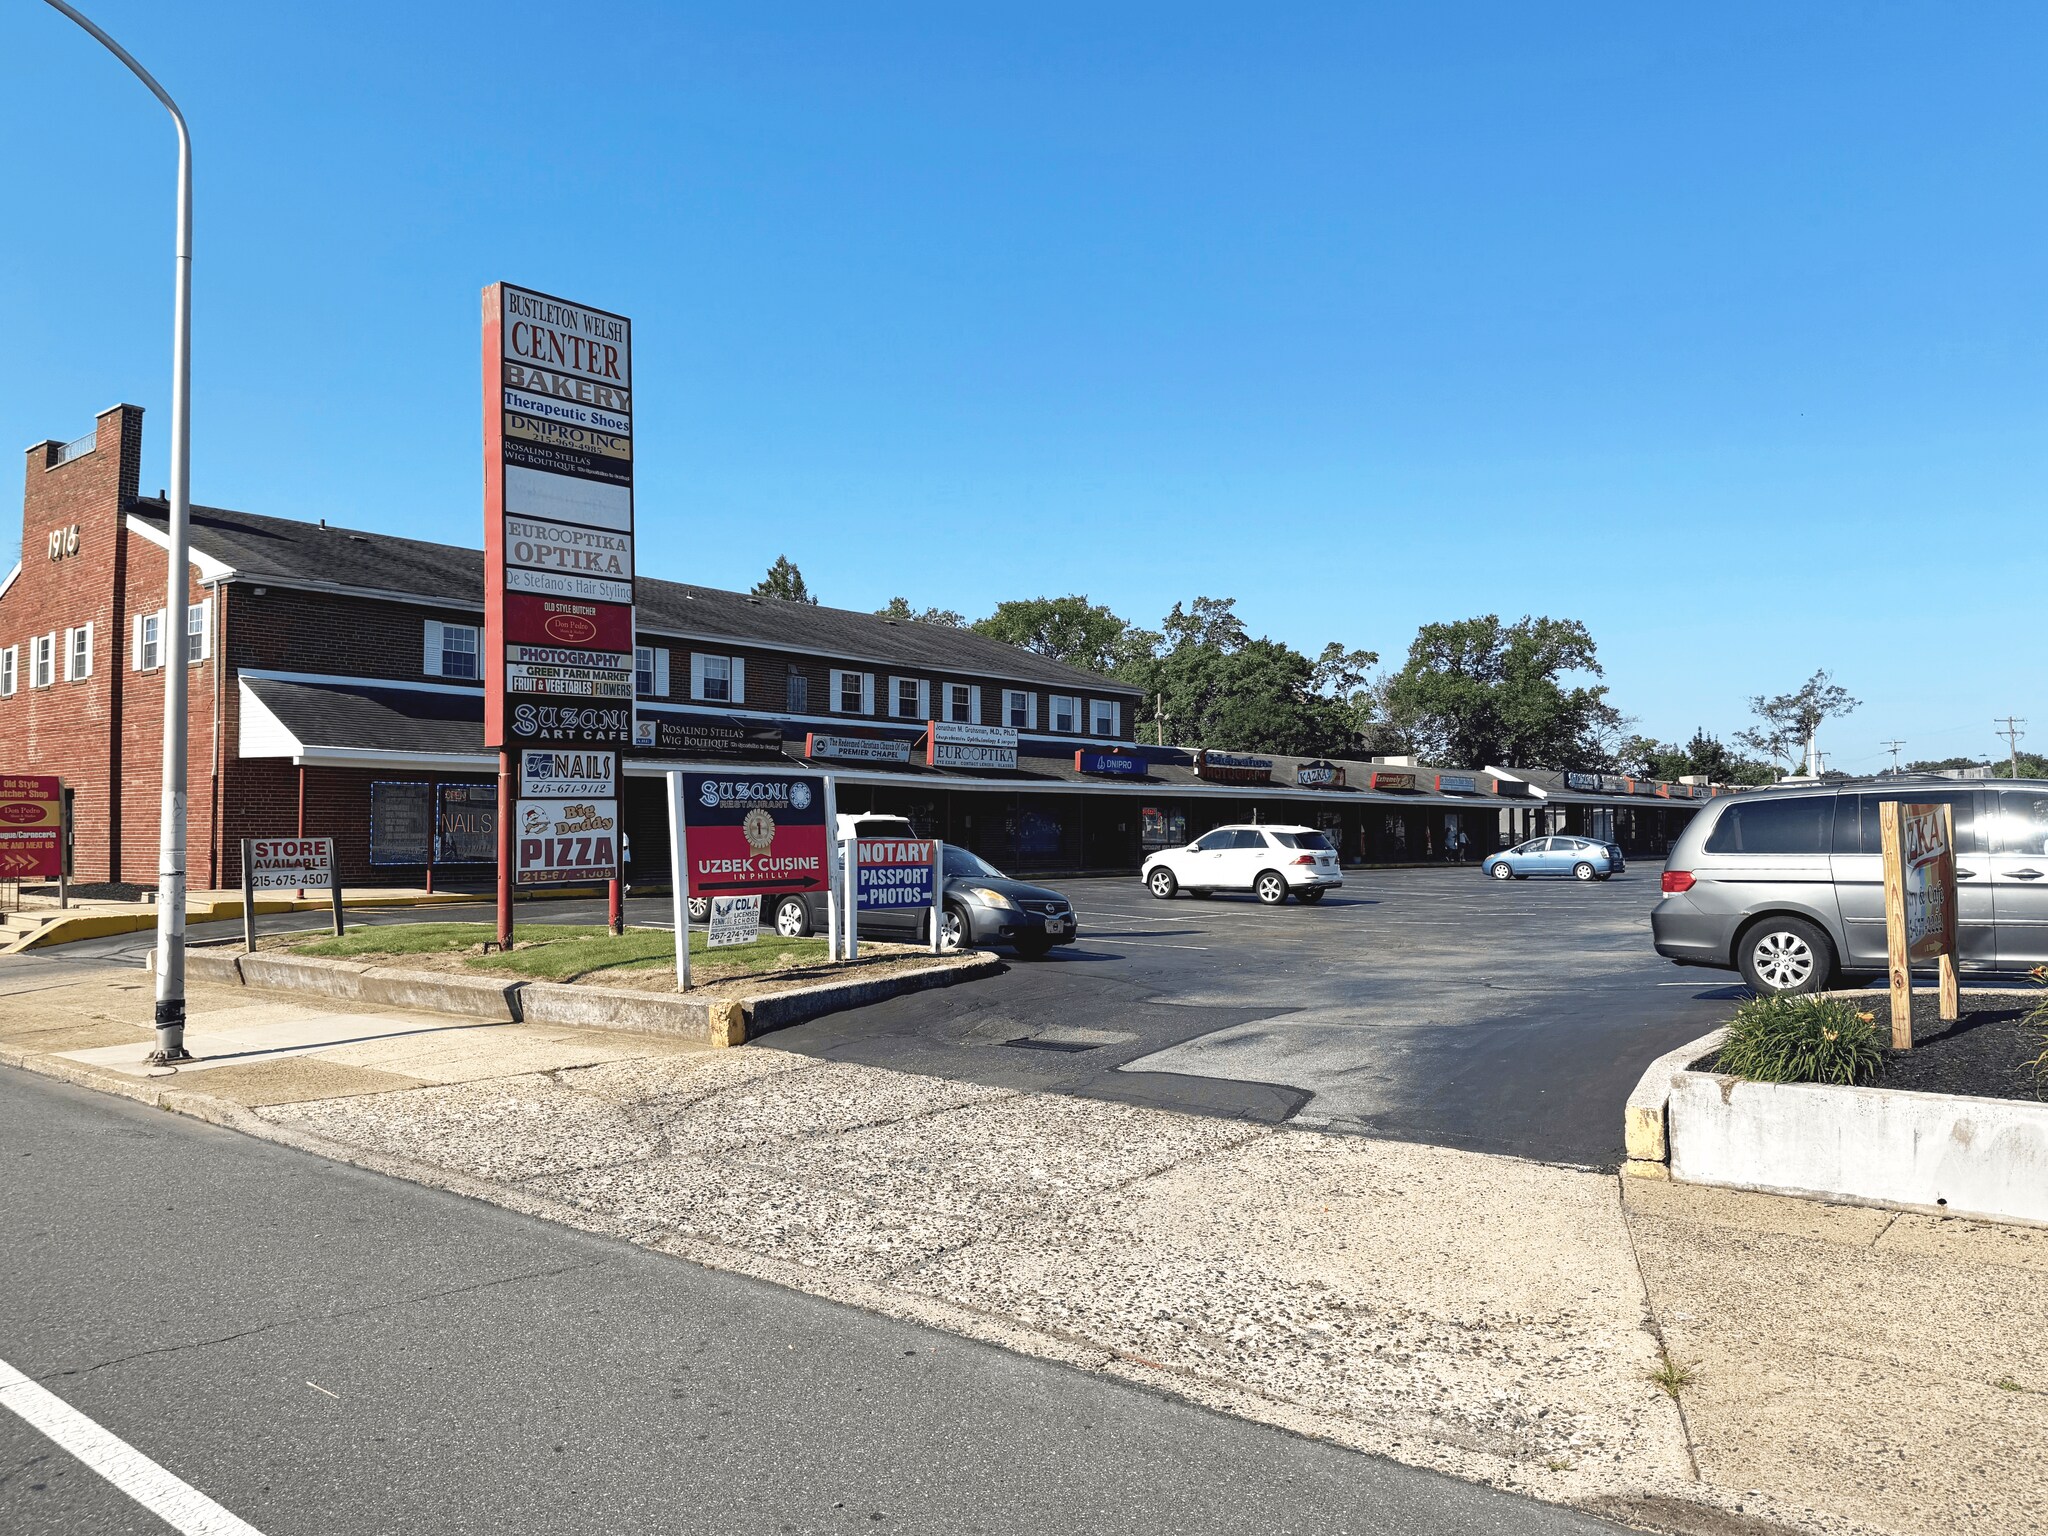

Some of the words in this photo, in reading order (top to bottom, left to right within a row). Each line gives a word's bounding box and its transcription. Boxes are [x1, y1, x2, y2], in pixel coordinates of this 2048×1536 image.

[509, 293, 578, 331] BUSTLETON
[583, 314, 623, 343] WELSH
[512, 321, 620, 380] CENTER
[504, 364, 630, 411] BAKERY
[505, 391, 586, 422] Therapeutic
[591, 412, 629, 432] Shoes
[511, 416, 584, 442] DNIPRO
[590, 431, 626, 452] INC.
[505, 441, 552, 458] ROSALIND
[555, 451, 591, 466] STELLA'S
[505, 451, 525, 463] WIG
[528, 455, 575, 472] BOUTIQUE
[48, 524, 80, 562] 1916
[514, 541, 623, 574] OPTIKA
[507, 571, 520, 585] De
[524, 574, 573, 592] Stefano's
[576, 579, 597, 595] Hair
[600, 583, 631, 603] Styling
[544, 602, 556, 612] OLD
[556, 603, 572, 613] STYLE
[572, 604, 597, 615] BUTCHER
[555, 620, 569, 628] Don
[570, 621, 588, 631] Pedro
[520, 647, 620, 667] PHOTOGRAPHY
[526, 666, 561, 678] GREEN
[562, 669, 590, 680] FARM
[592, 672, 630, 682] MARKET
[513, 677, 537, 691] FRUIT
[538, 679, 544, 690] &
[545, 678, 592, 695] VEGETABLES
[595, 682, 631, 697] FLOWERS
[540, 729, 576, 740] ART
[583, 730, 628, 741] CAFE
[662, 723, 707, 736] ROSALIND
[710, 726, 744, 739] STELLA'S
[662, 735, 681, 745] WIG
[684, 736, 729, 749] BOUTIQUE
[829, 737, 838, 746] The
[838, 748, 869, 756] PREMIER
[871, 749, 899, 758] CHAPEL
[554, 754, 611, 780] NAILS
[1106, 759, 1132, 769] DNIPRO
[4, 780, 17, 788] Old
[18, 780, 39, 789] Style
[1300, 769, 1328, 784] KAZKA
[0, 790, 27, 798] utcher
[29, 790, 48, 799] Shop
[531, 784, 607, 793] 215-671-9112
[564, 804, 596, 819] Big
[719, 800, 789, 809] RESTAURANT
[441, 813, 492, 833] NAILS
[554, 817, 613, 836] Daddy
[45, 841, 54, 849] US
[255, 841, 327, 858] STORE
[520, 837, 614, 869] PIZZA
[858, 843, 930, 863] NOTARY
[254, 857, 327, 869] AVAILABLE
[699, 859, 754, 874] UZBEK
[758, 857, 819, 871] CUISINE
[252, 874, 328, 887] 215-675-4507
[750, 871, 789, 879] PHILLY
[860, 868, 928, 886] PASSPORT
[736, 898, 751, 910] CDL
[752, 897, 759, 909] A
[870, 887, 921, 905] PHOTOS
